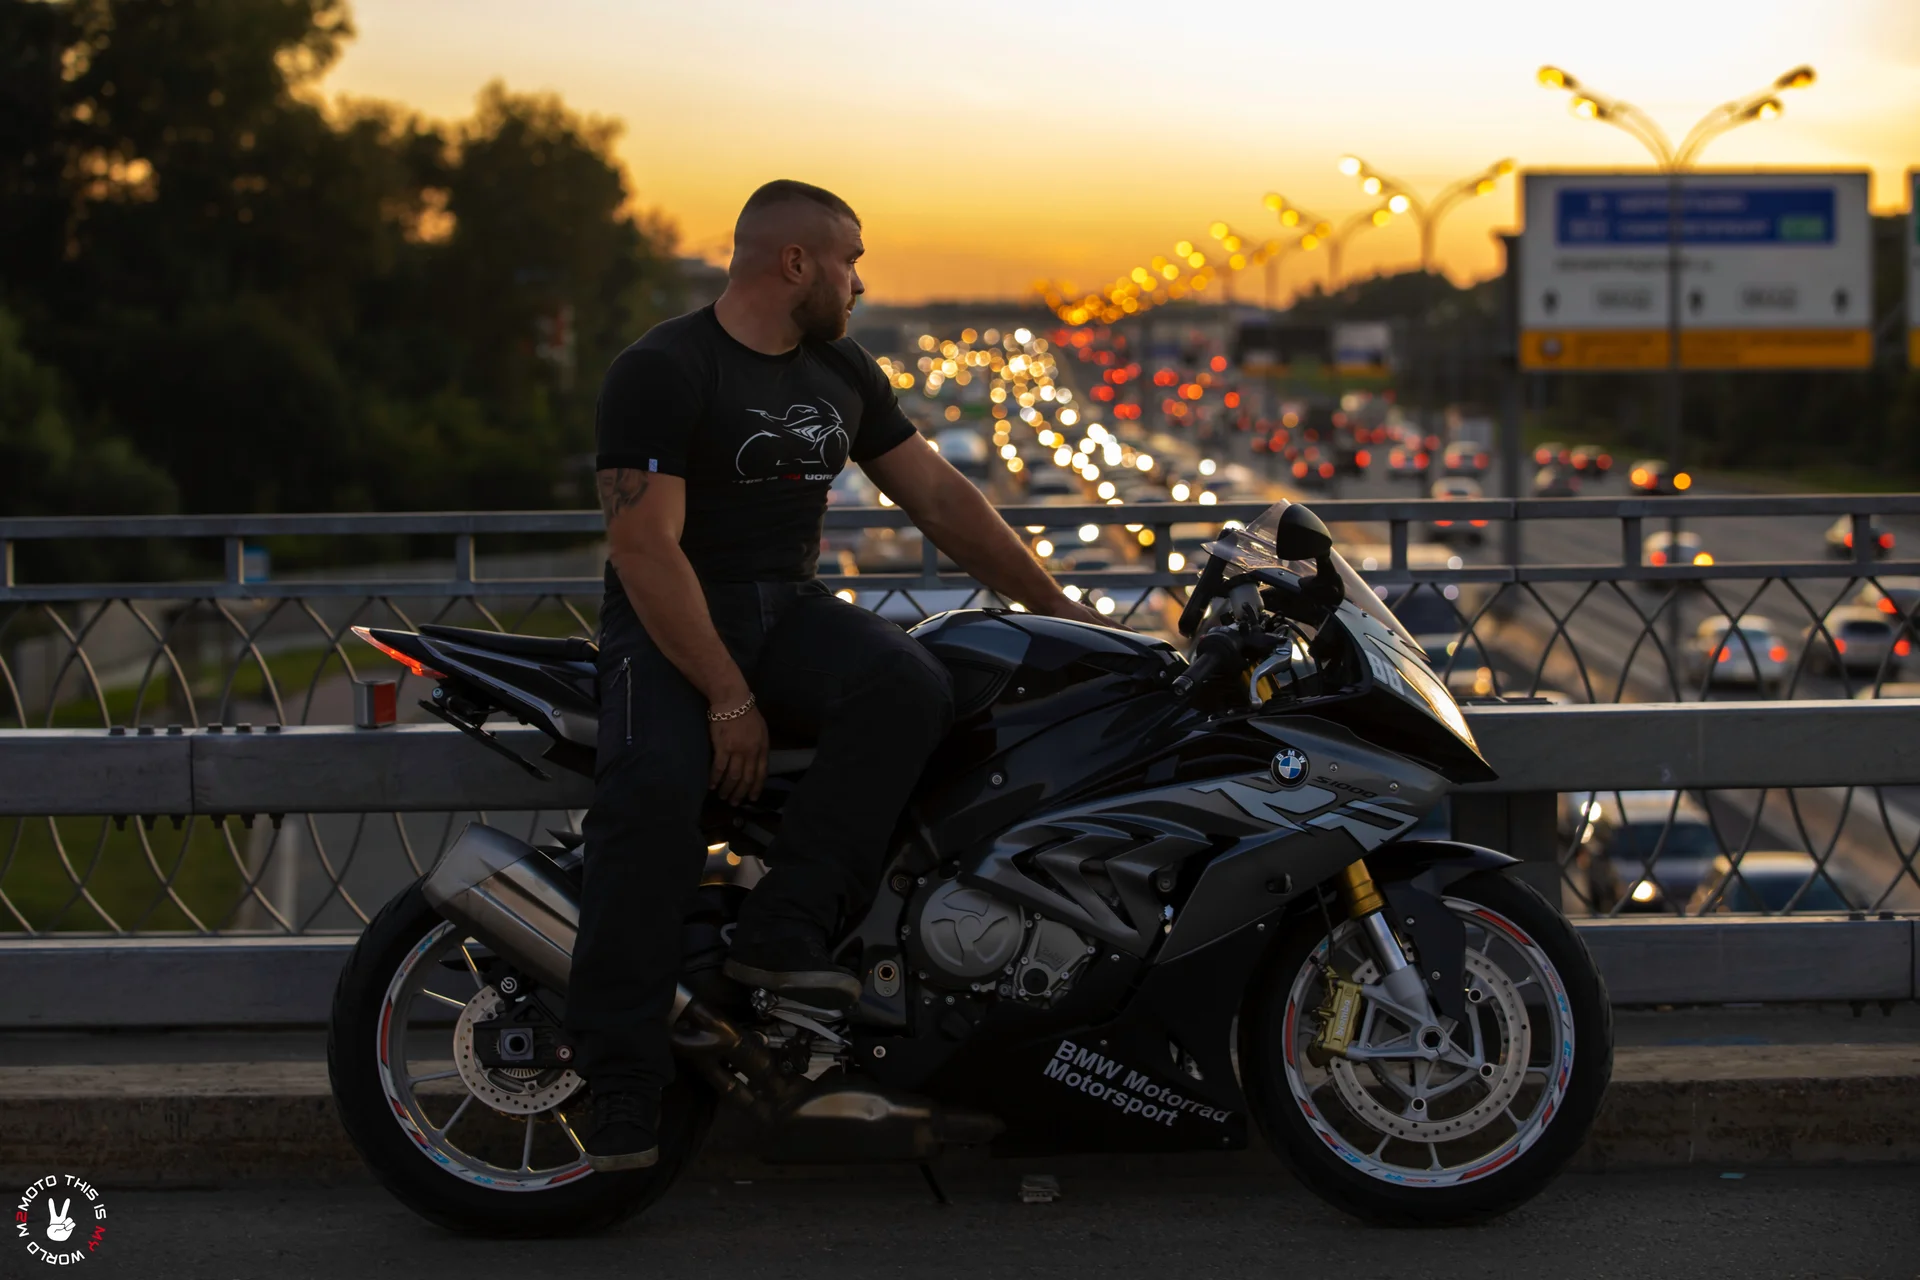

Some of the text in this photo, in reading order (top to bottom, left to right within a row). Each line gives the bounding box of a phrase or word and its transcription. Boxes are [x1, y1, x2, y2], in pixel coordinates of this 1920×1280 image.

[804, 473, 837, 481] WORL
[1276, 750, 1306, 763] BMW
[1312, 776, 1378, 798] S1000
[1335, 1000, 1352, 1037] brembo
[1043, 1058, 1179, 1126] Motorsport
[1055, 1040, 1232, 1122] BMW Motorrad
